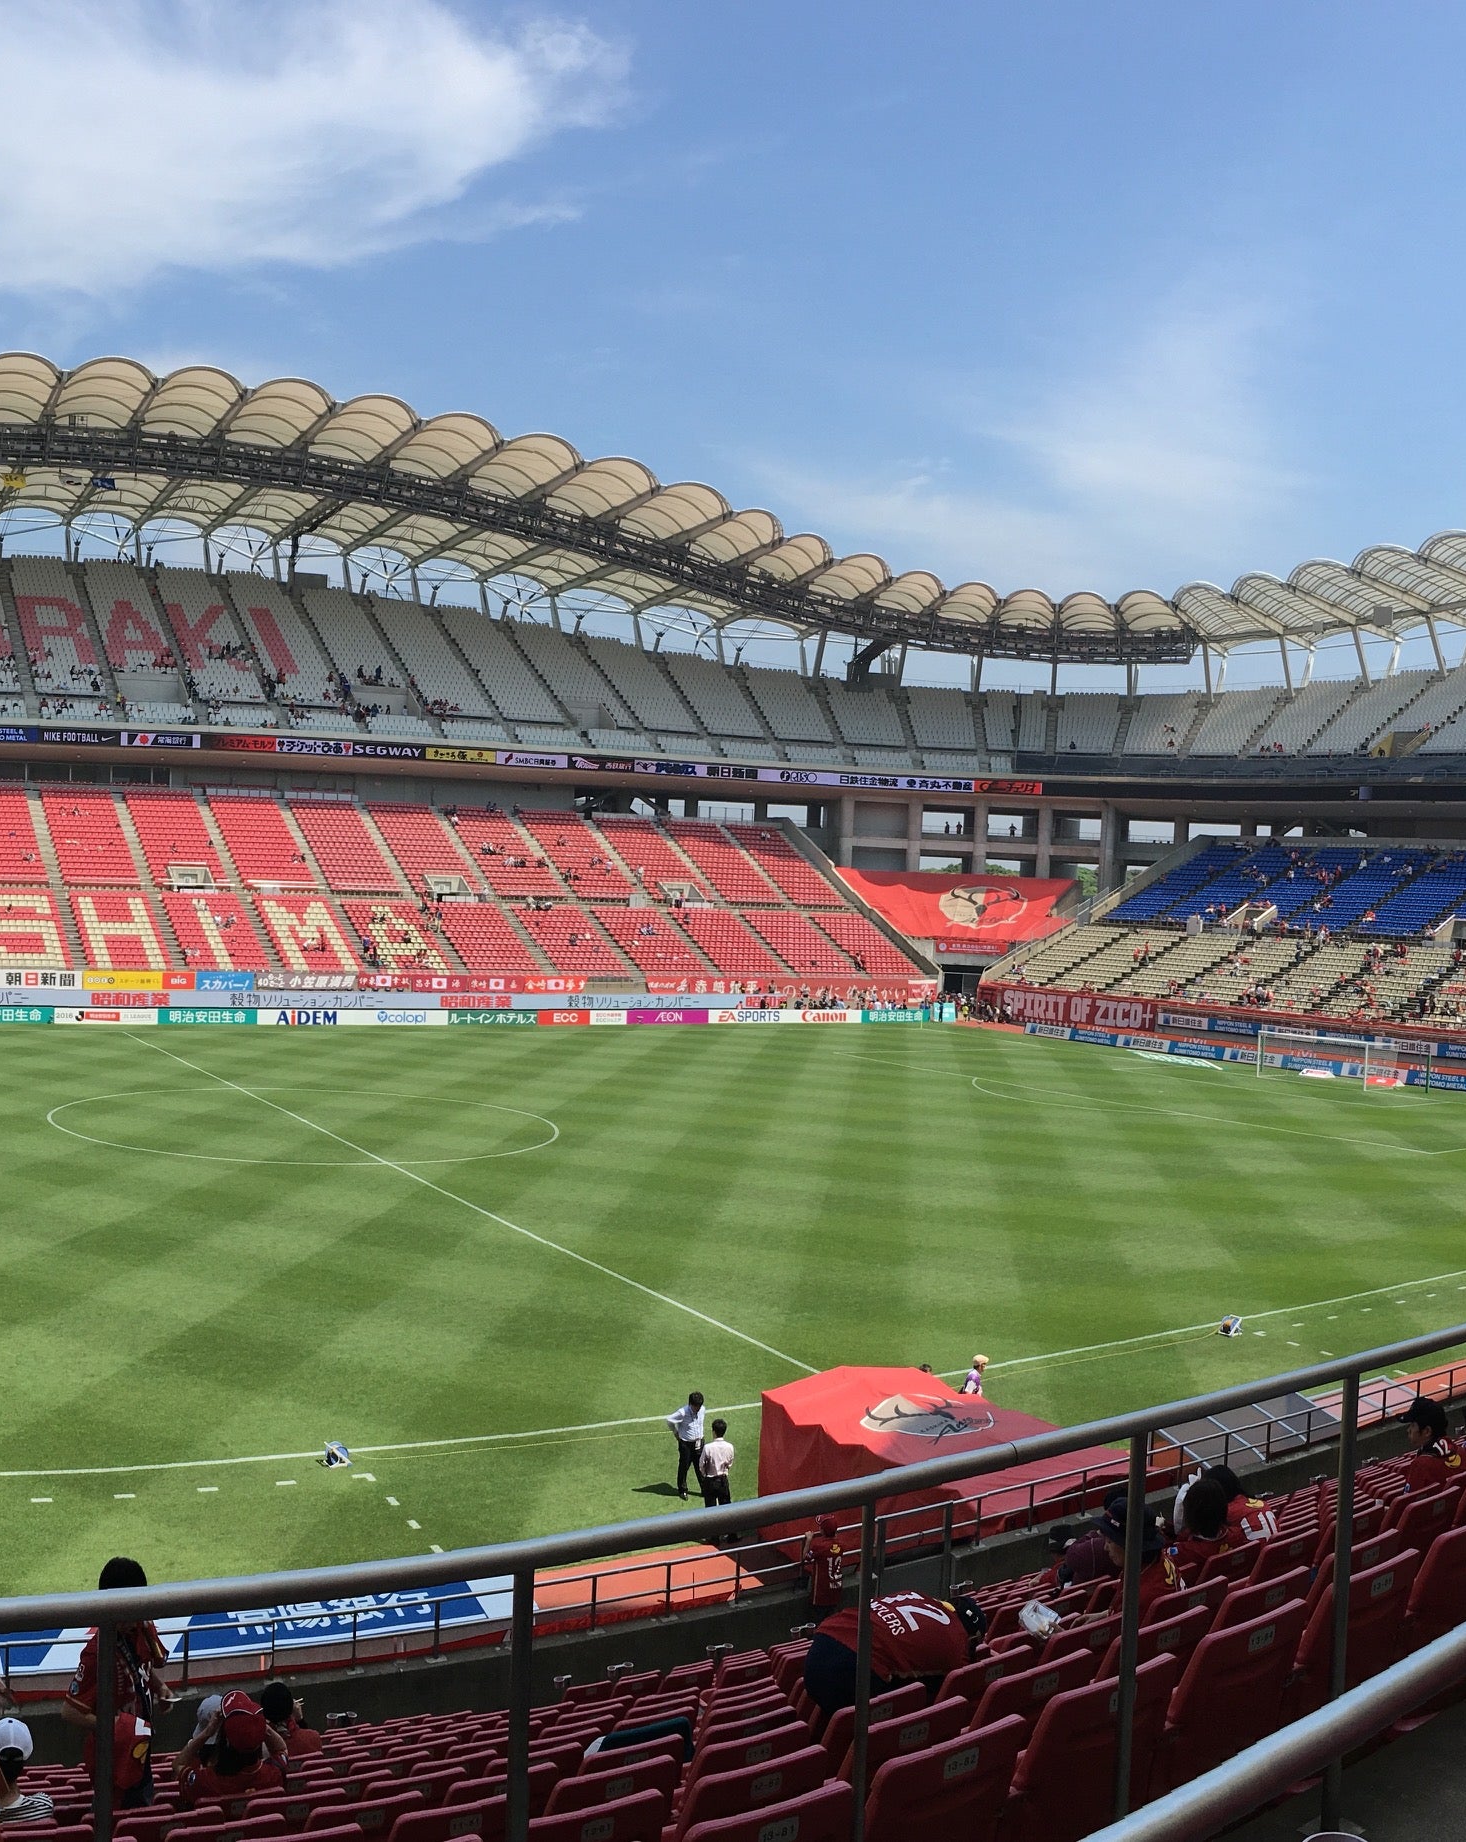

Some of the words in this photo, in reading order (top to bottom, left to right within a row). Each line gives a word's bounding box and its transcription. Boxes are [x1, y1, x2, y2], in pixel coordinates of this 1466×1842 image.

[43, 731, 61, 742] NIKE
[62, 732, 99, 743] FOOTBALL
[353, 744, 422, 757] SEGWAY
[5, 972, 76, 987] 朝日新聞
[91, 992, 171, 1006] 昭和産業
[440, 994, 513, 1009] 昭和産業
[1004, 990, 1067, 1020] SPIRIT
[1070, 994, 1091, 1021] OF
[169, 1010, 246, 1023] 明治安田生命
[552, 1012, 579, 1023] ECC
[737, 1011, 780, 1023] SPORTS
[801, 1010, 847, 1023] Canon
[869, 1010, 923, 1022] 明治安田生命
[1432, 1438, 1453, 1456] 12
[870, 1598, 906, 1637] NTLERS
